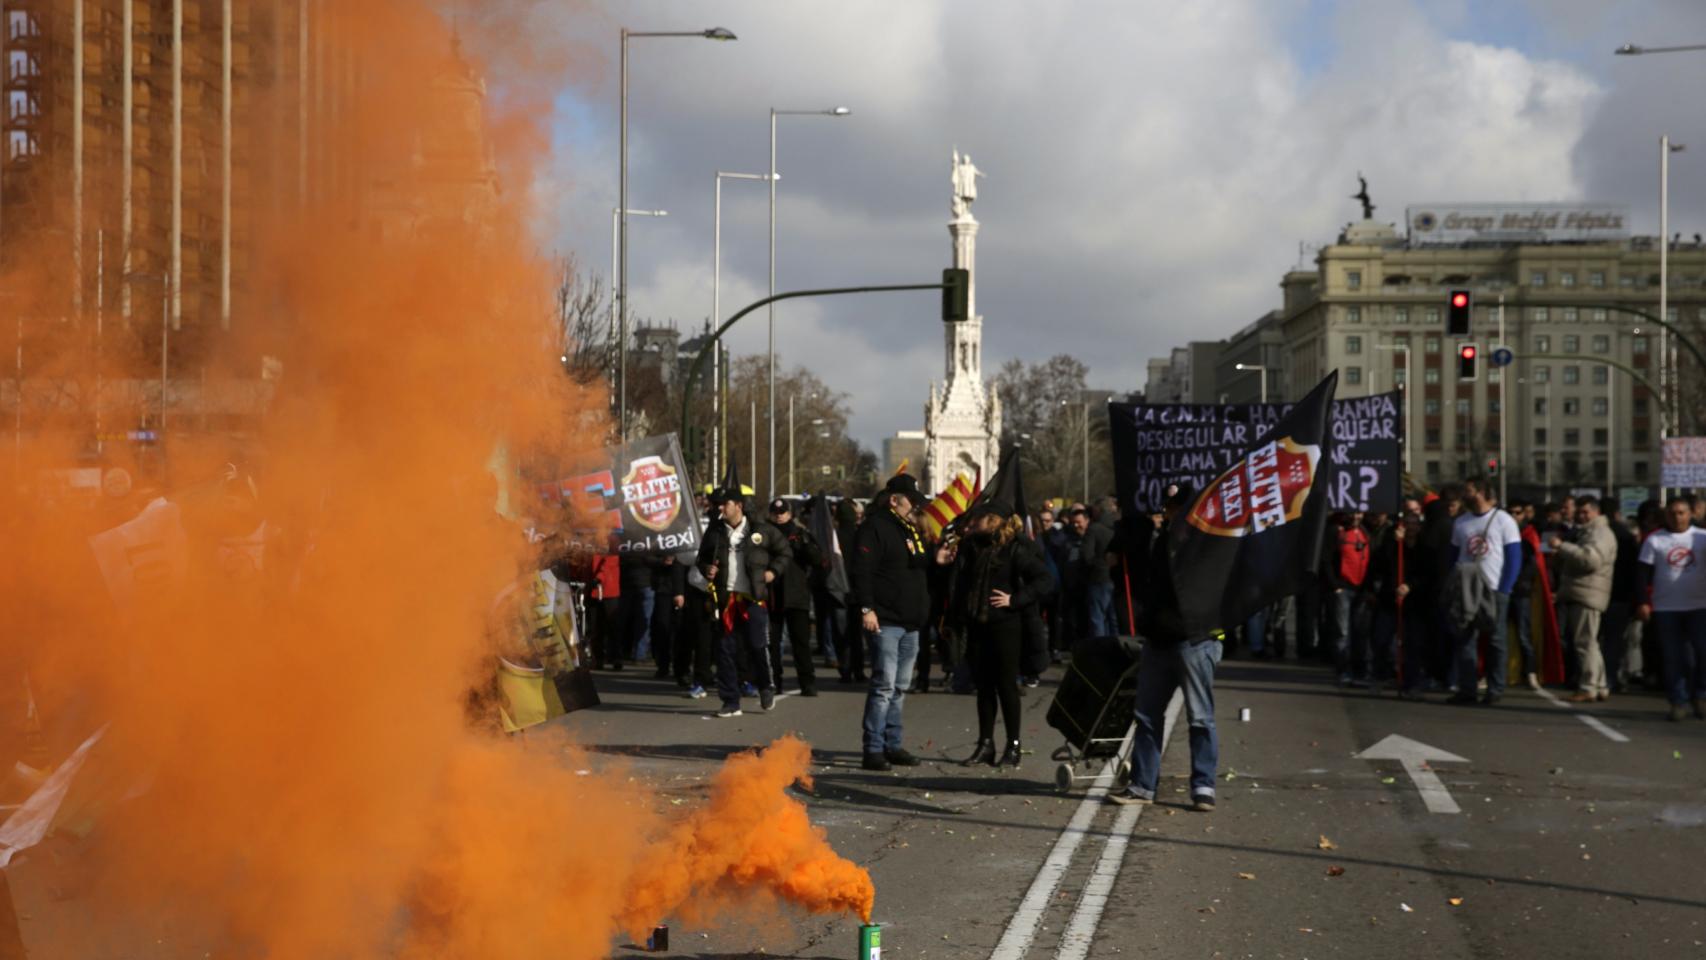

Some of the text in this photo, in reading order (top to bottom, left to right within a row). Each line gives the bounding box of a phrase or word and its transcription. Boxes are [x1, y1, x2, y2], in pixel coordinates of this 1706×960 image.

[1332, 396, 1396, 420] RAMPA
[1137, 425, 1247, 450] DESREGULAR
[1332, 419, 1396, 445] QUEAR
[1136, 453, 1155, 474] LO
[1161, 450, 1216, 473] LLAMA
[621, 473, 681, 503] ELITE
[1221, 475, 1243, 522] TAXI
[1249, 441, 1286, 533] ELITE
[640, 498, 673, 516] TAXI
[657, 527, 694, 550] taxi
